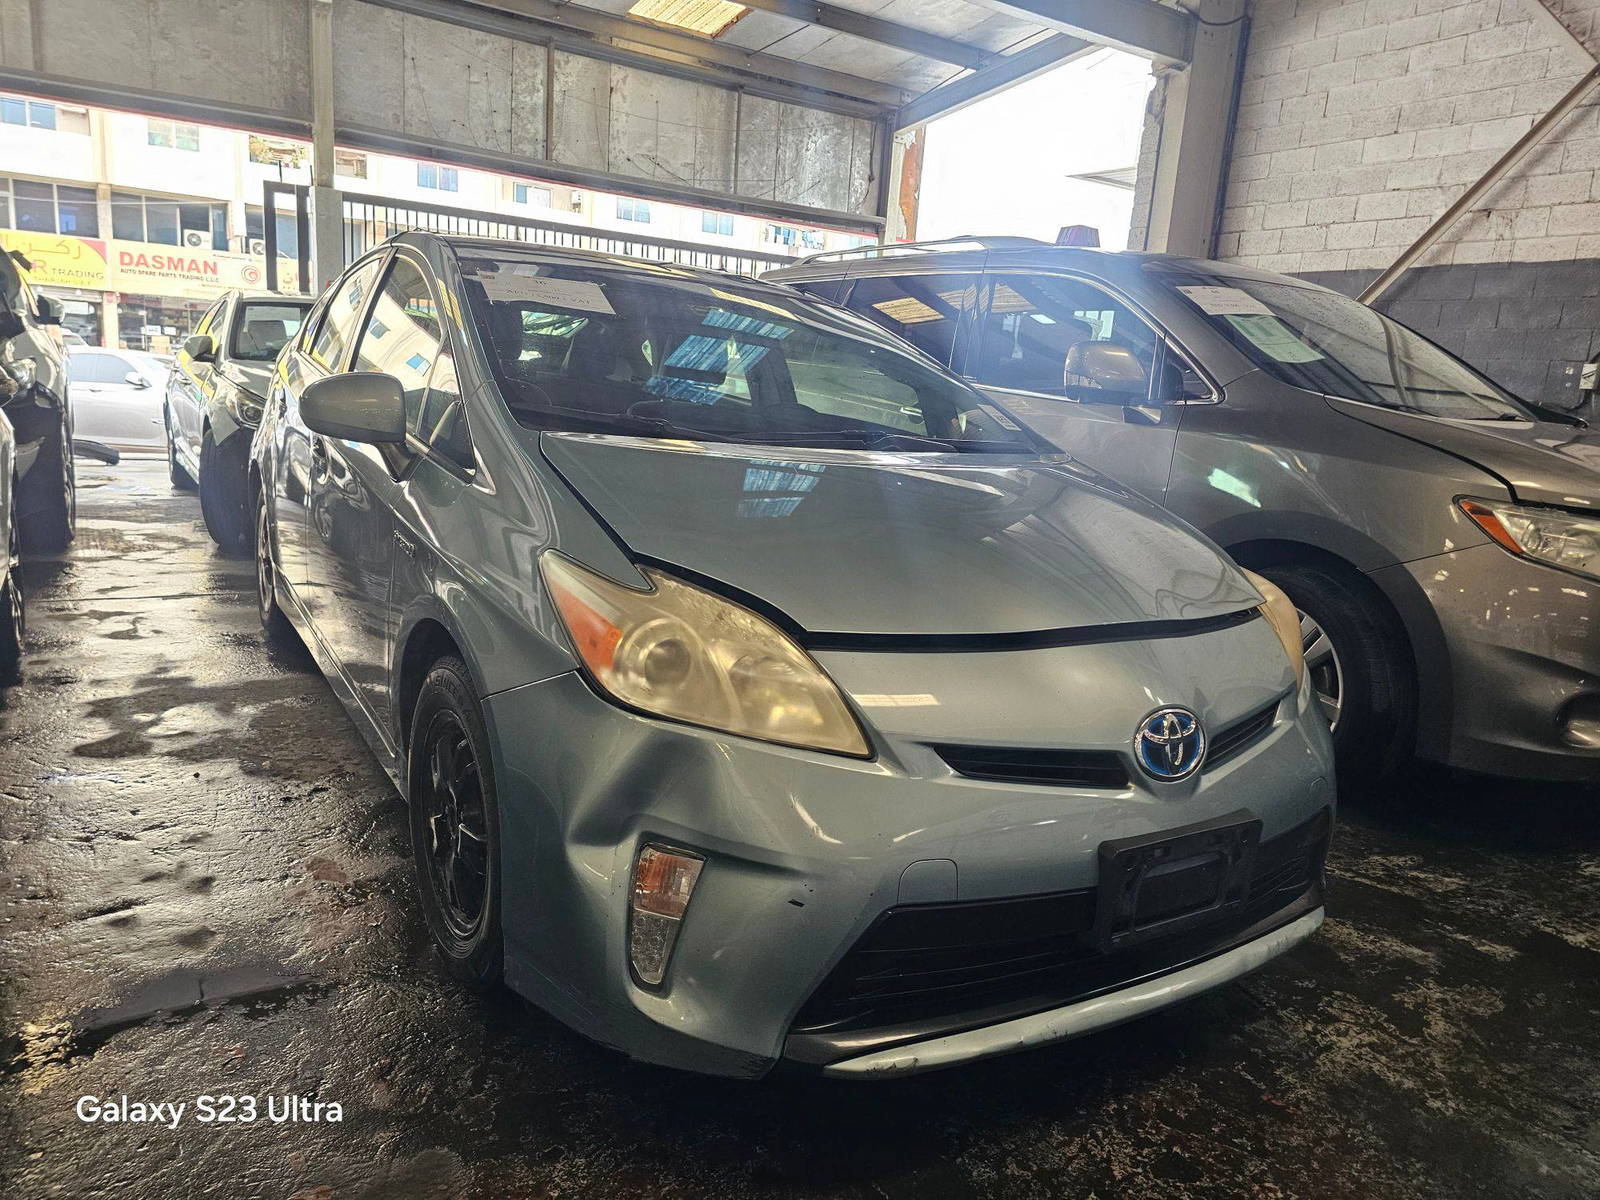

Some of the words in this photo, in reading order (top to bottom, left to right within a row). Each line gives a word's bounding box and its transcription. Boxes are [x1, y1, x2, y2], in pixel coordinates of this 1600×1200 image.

[119, 251, 218, 276] DASMAN
[52, 267, 104, 280] TRADING
[179, 273, 204, 281] TRADING
